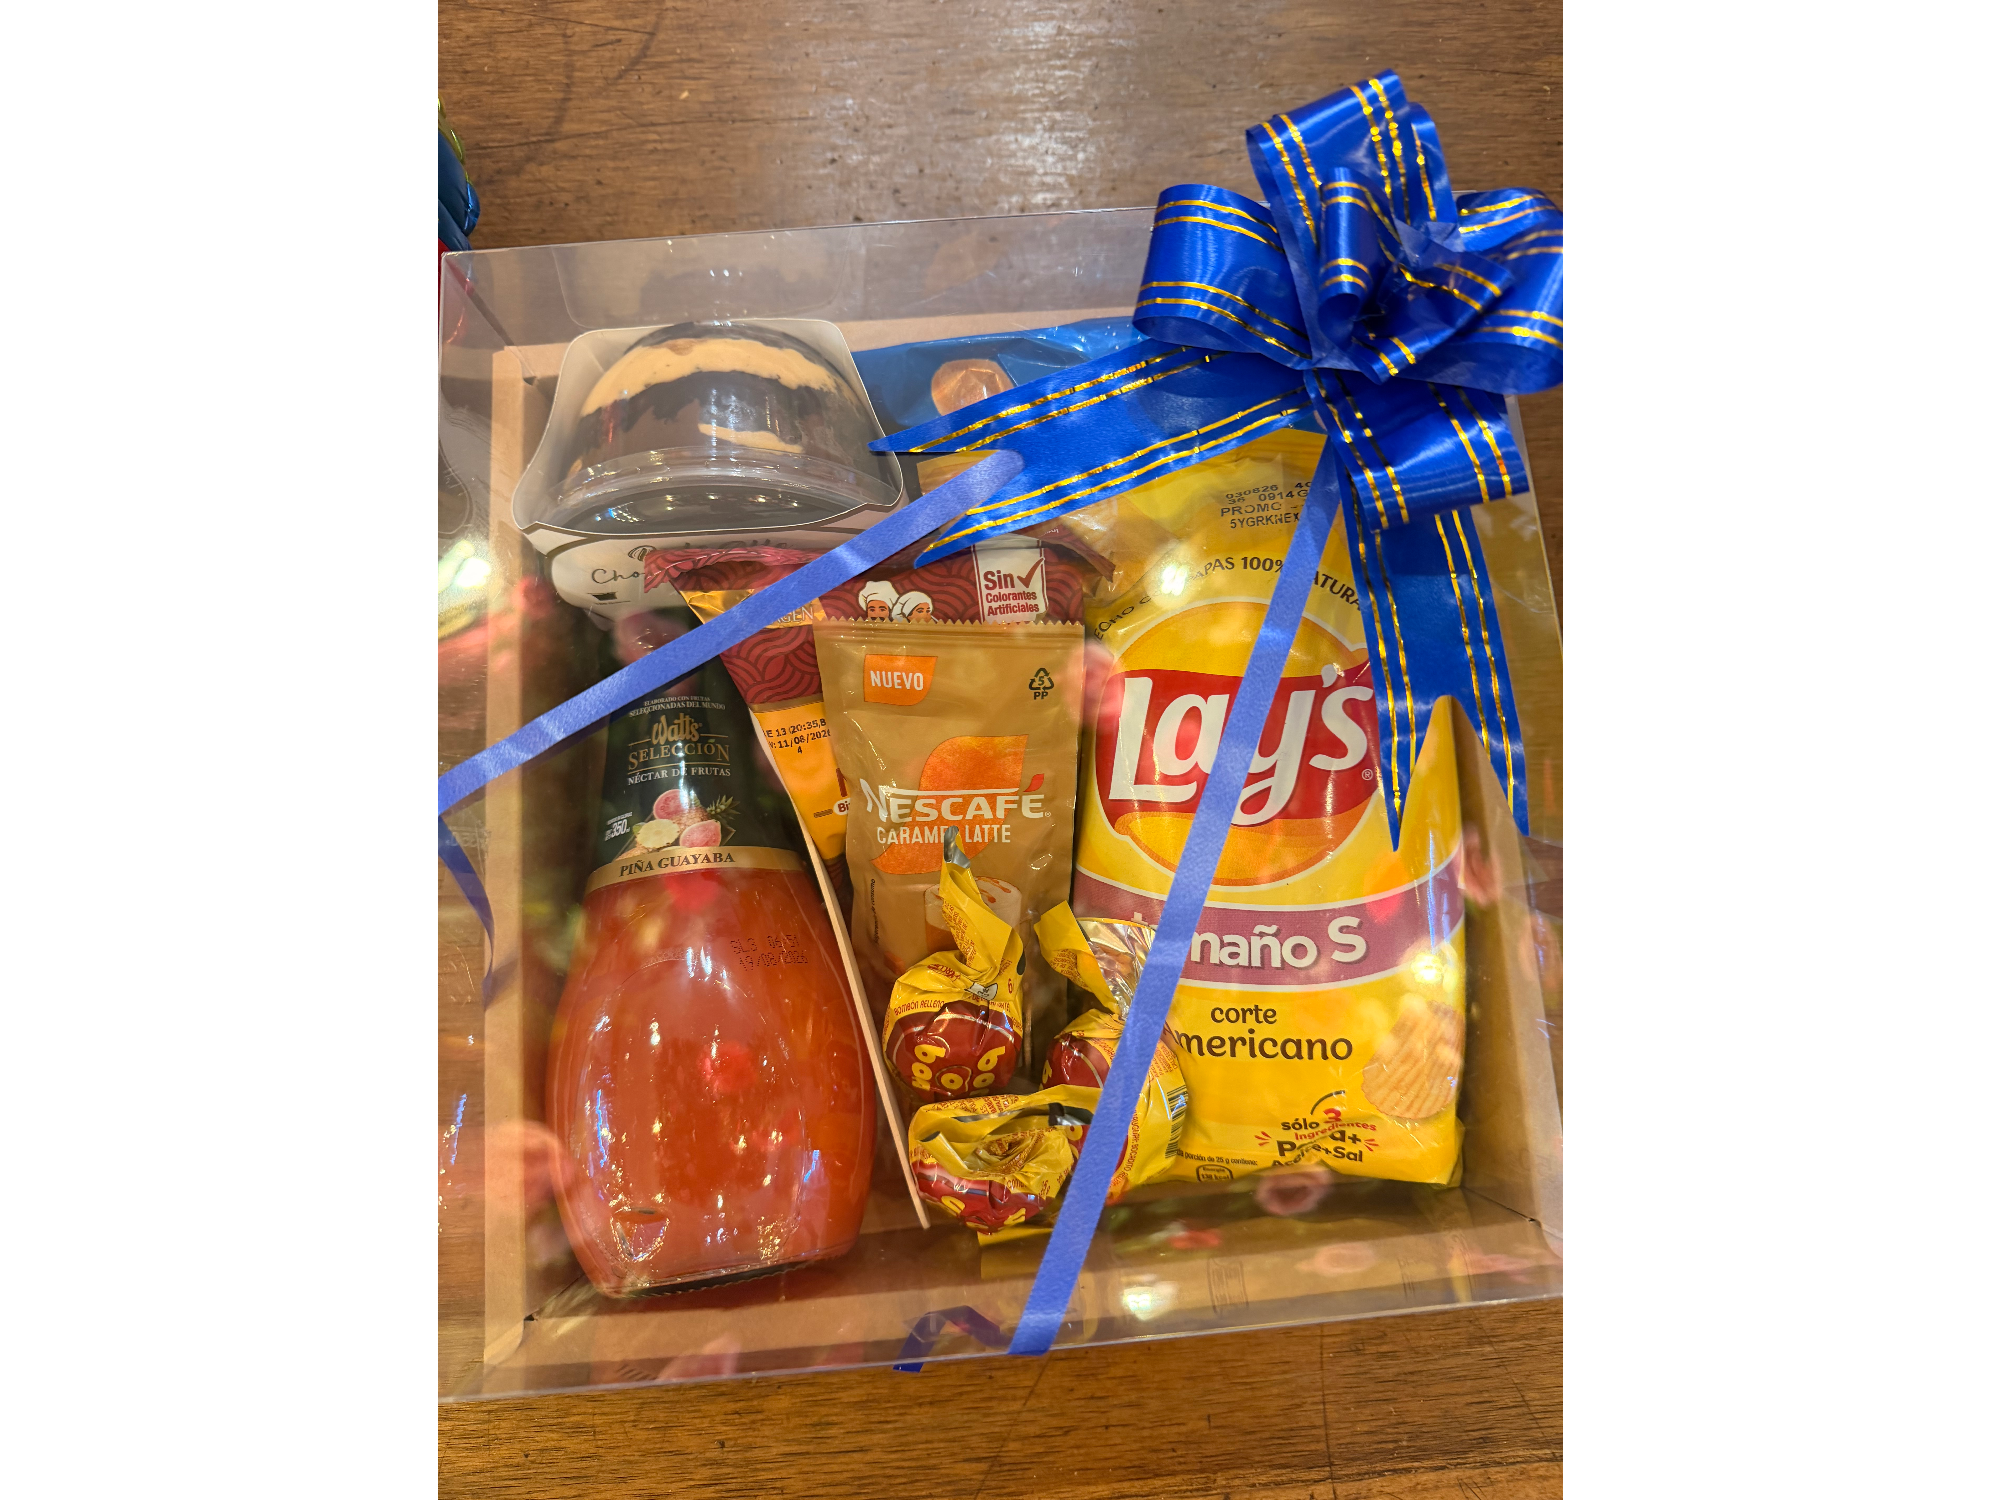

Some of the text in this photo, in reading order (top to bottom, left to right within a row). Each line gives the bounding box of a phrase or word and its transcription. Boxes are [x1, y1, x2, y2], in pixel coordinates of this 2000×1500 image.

[1225, 485, 1278, 499] 030826
[983, 570, 1015, 590] Sin
[985, 590, 1037, 604] Colorantes
[987, 602, 1040, 617] Artificiales
[870, 670, 924, 691] NUEVO
[644, 696, 677, 706] ELABORADO
[1033, 691, 1049, 700] PP
[629, 702, 686, 718] SELECCIONADAS
[702, 701, 726, 710] MUNDO
[776, 728, 786, 737] 13
[628, 739, 730, 770] SELECCIÓN
[1108, 662, 1374, 827] Lay's
[628, 767, 731, 785] NÉCTAR DE FRUTAS
[860, 773, 1044, 823] NESCAFÉ
[877, 824, 1011, 844] CARAME LATTE
[619, 852, 736, 877] PIÑA GUAYABA
[1190, 915, 1367, 968] maño S
[1210, 1004, 1277, 1025] corte
[1281, 1108, 1342, 1131] sólo 3
